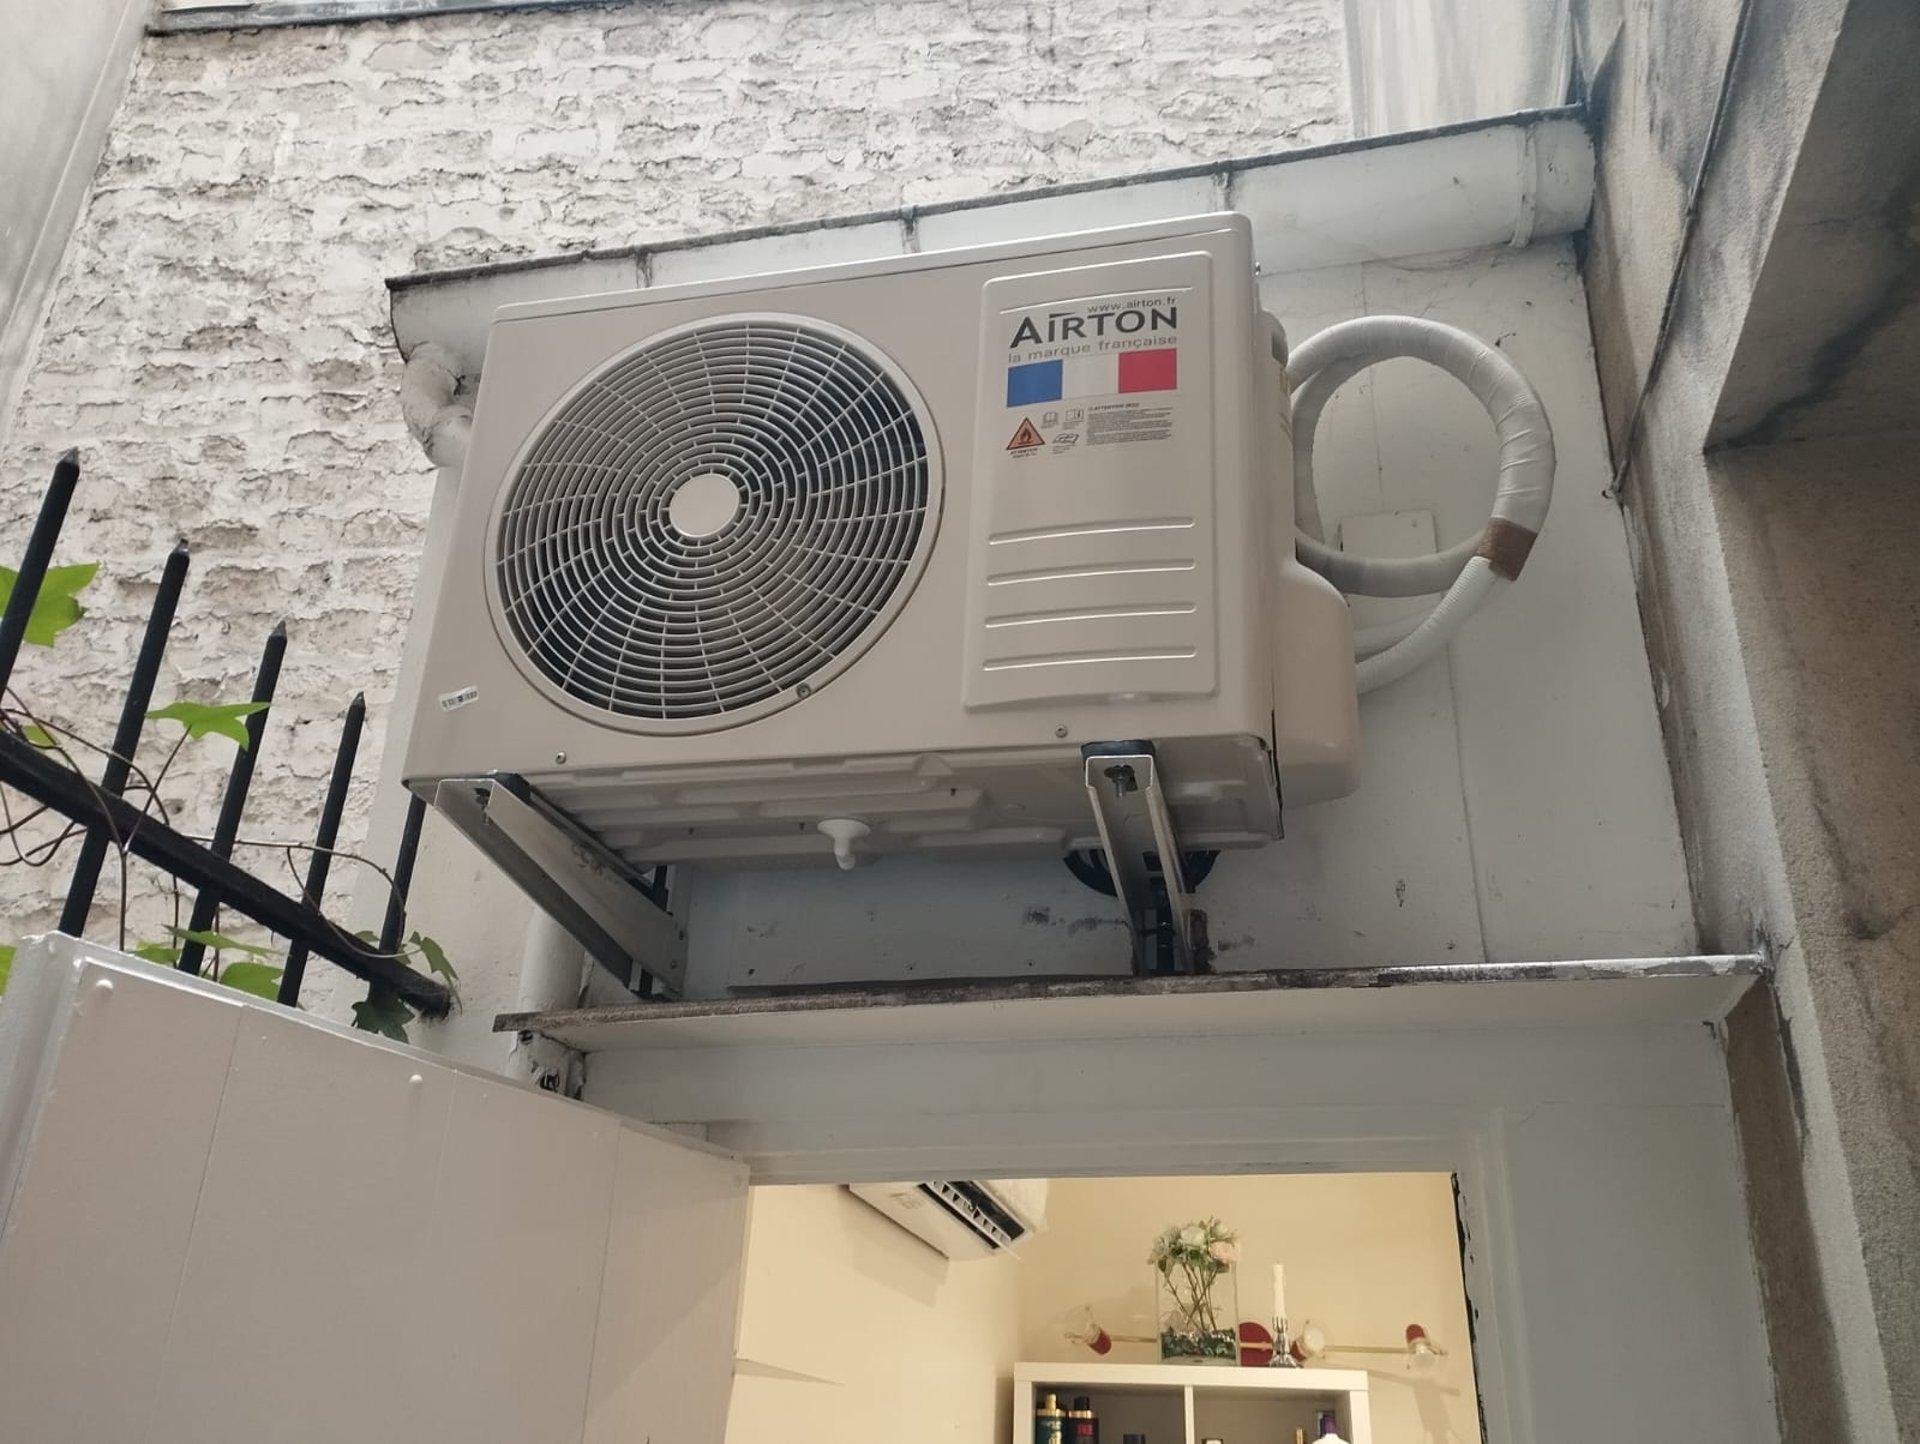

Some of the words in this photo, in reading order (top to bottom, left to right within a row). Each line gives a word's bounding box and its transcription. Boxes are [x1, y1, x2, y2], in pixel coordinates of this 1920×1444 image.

[1087, 296, 1177, 312] www.airton.fr
[1008, 353, 1021, 363] la
[1028, 344, 1091, 360] marque
[1098, 335, 1177, 350] française
